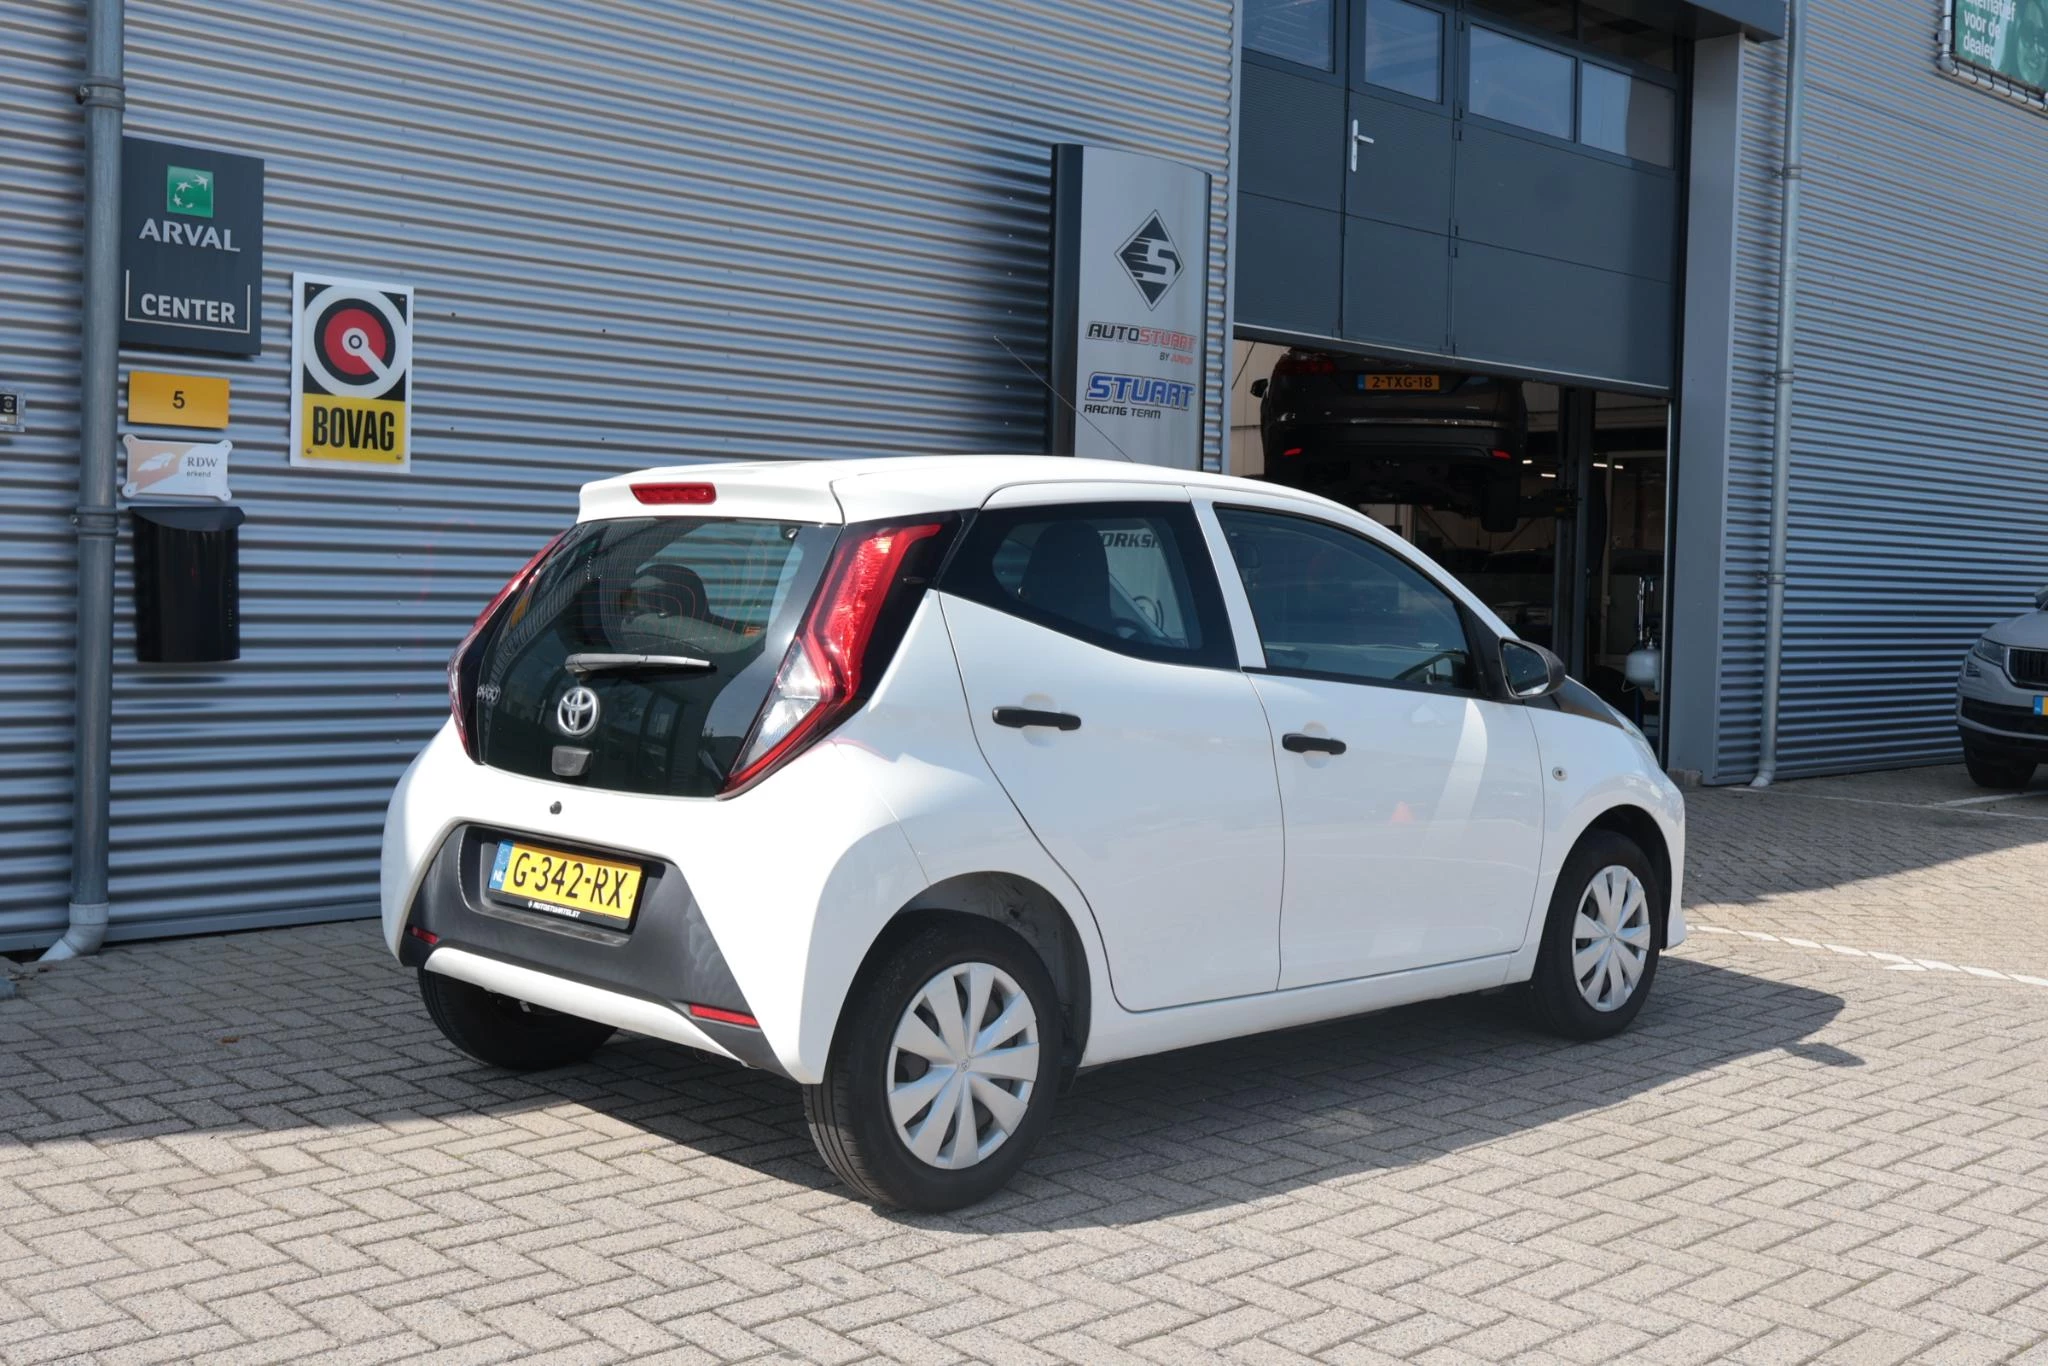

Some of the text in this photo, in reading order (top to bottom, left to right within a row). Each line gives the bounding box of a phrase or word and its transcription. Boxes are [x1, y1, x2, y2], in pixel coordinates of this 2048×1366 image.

[1964, 10, 2001, 39] voor de
[1963, 30, 1995, 60] dealer
[139, 217, 241, 253] ARVAL
[140, 293, 236, 324] CENTER
[1087, 321, 1196, 352] AUTOSTUART
[1159, 351, 1170, 361] BY
[1085, 371, 1195, 411] STUART
[1371, 376, 1433, 389] 2-TXG-18
[172, 390, 185, 409] 5
[1084, 404, 1161, 419] RACING TEAM
[313, 406, 395, 451] BOVAG
[187, 456, 218, 467] RDW
[493, 869, 504, 882] NL
[513, 852, 628, 909] G-342-RX
